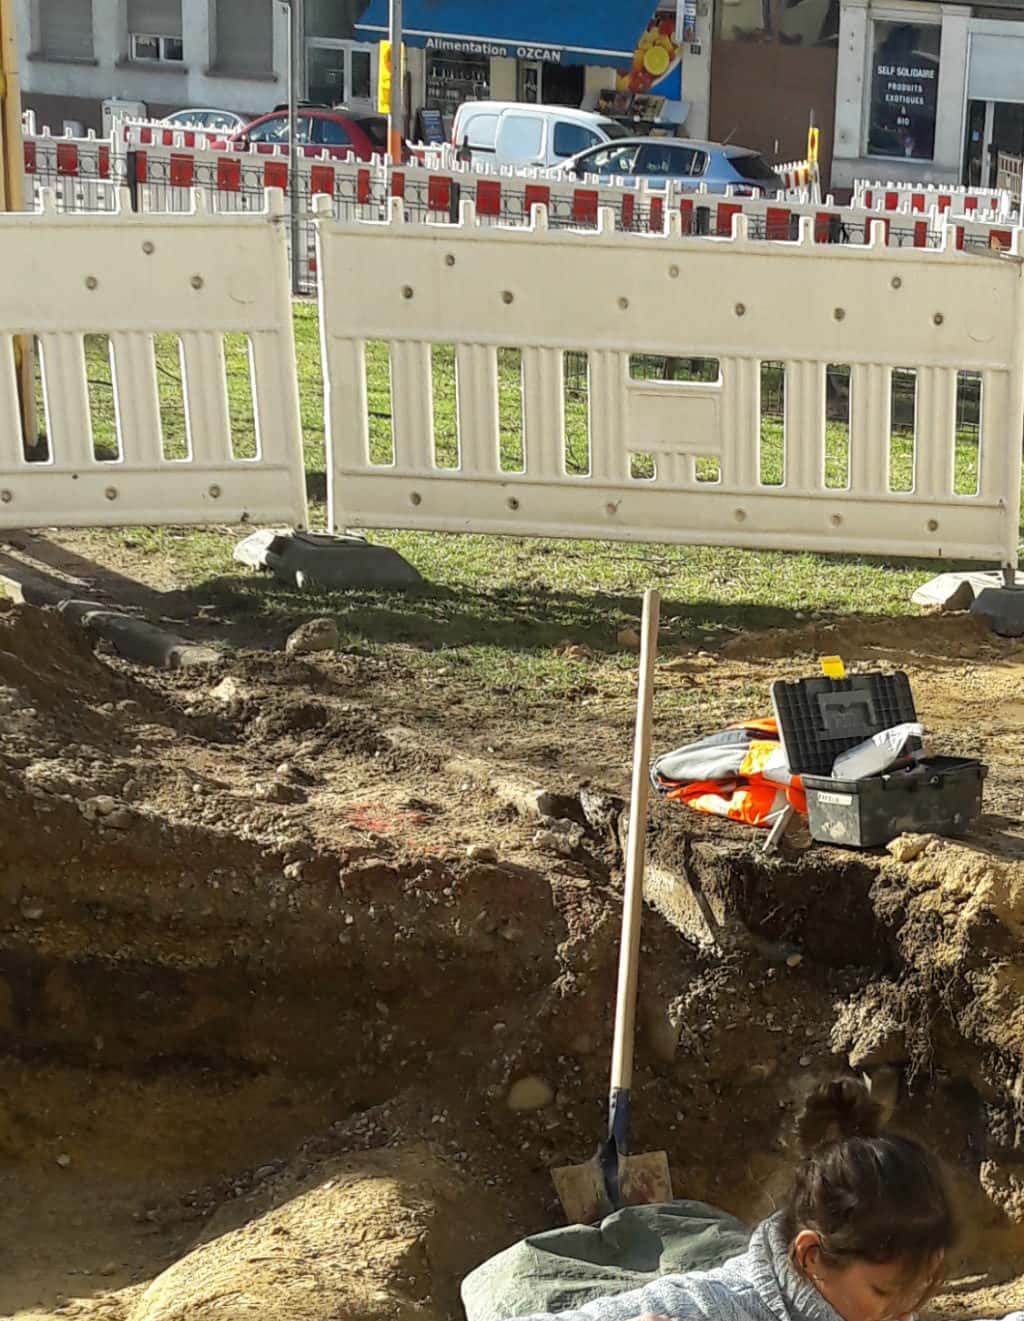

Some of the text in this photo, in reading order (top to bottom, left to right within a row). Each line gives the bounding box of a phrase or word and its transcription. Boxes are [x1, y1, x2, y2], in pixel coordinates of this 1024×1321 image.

[426, 37, 561, 63] Alimentation OZCAN
[877, 65, 935, 79] SELF SOLIDAIRE
[887, 82, 923, 93] PRODUITS
[885, 93, 924, 105] EXOTIQUES
